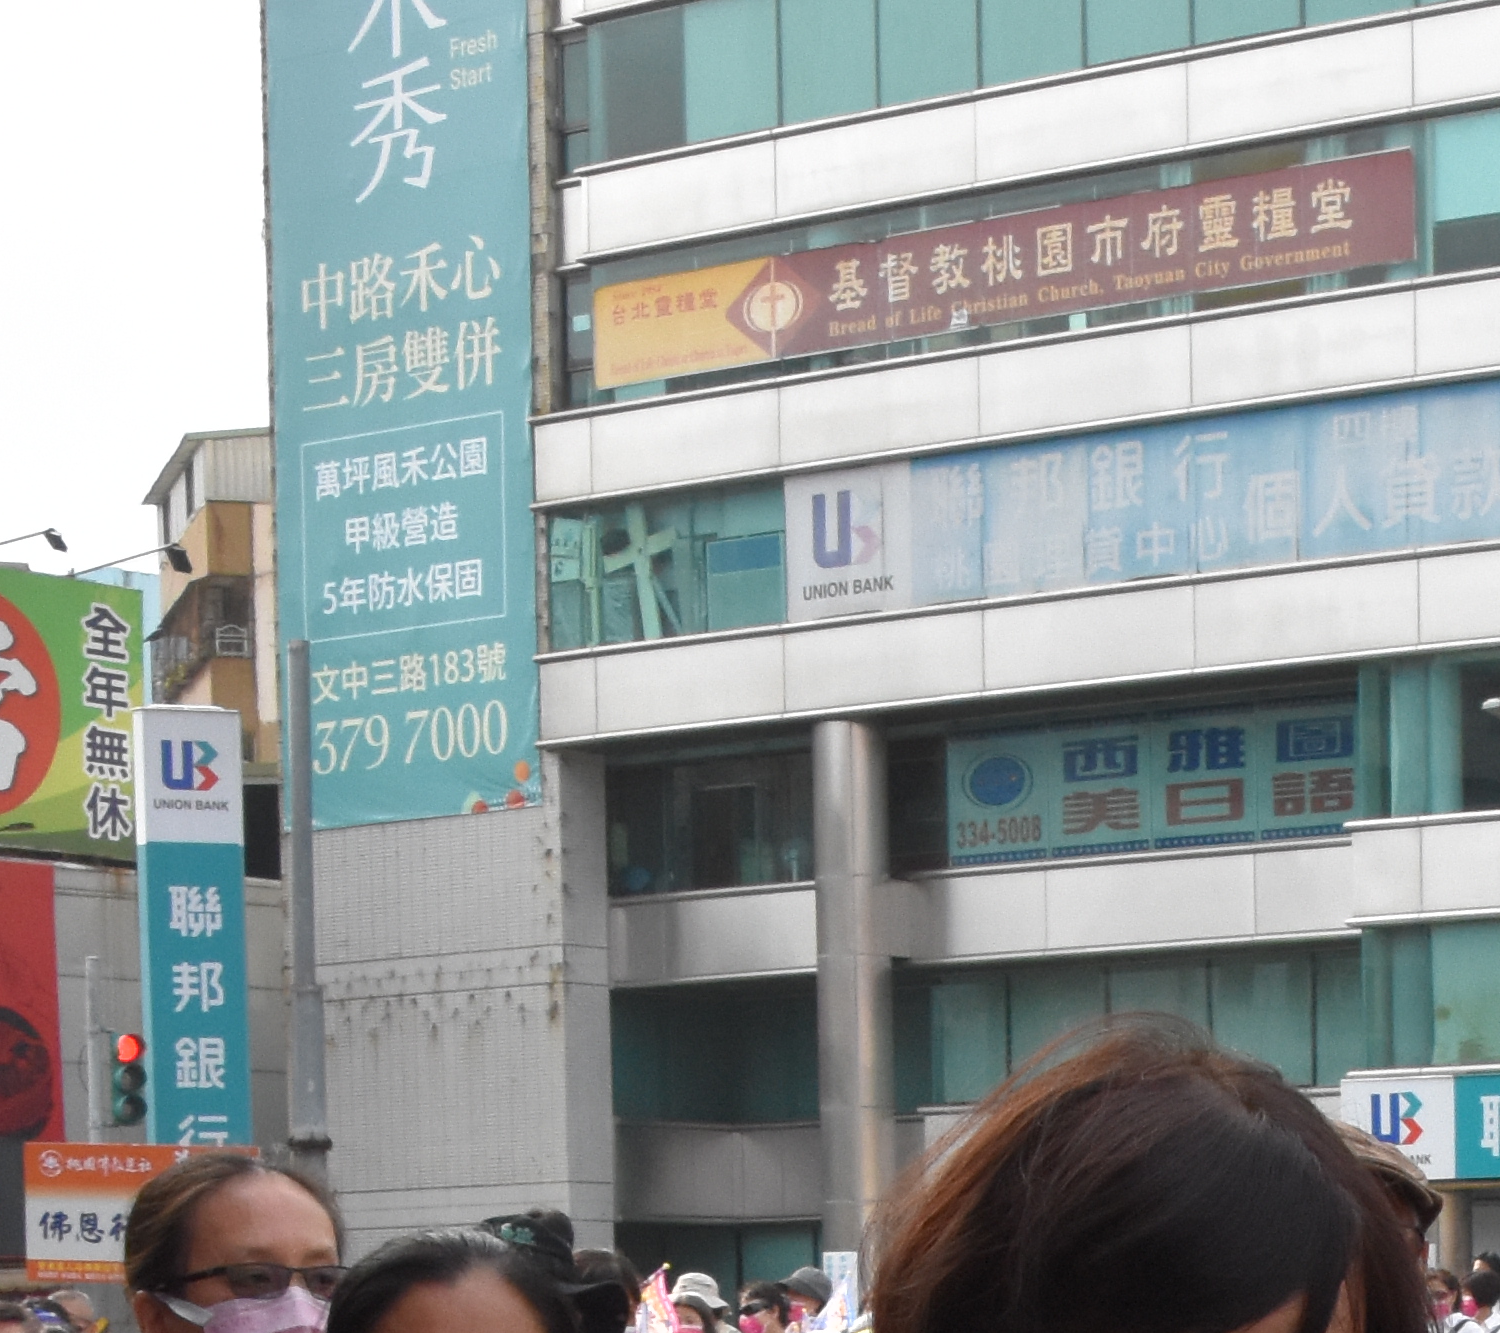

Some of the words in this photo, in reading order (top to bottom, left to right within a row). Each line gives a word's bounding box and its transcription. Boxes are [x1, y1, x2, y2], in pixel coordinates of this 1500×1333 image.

[449, 30, 498, 58] Fresh
[450, 63, 492, 90] Start
[829, 178, 1353, 311] 基督教桃園市府靈糧堂
[302, 235, 500, 331] 中路禾心
[828, 315, 877, 338] Bread
[885, 311, 902, 329] of
[909, 305, 942, 325] Life
[950, 292, 1029, 320] Christian
[1113, 266, 1187, 292] Taoyuan
[1195, 257, 1230, 281] City
[1239, 240, 1351, 271] Government
[303, 317, 501, 411] 三房雙併
[314, 437, 488, 501] 萬坪風禾公園
[345, 503, 459, 555] 甲級營造
[323, 559, 483, 615] 5年防水保固
[802, 580, 850, 602] UNION
[852, 574, 895, 596] BANK
[312, 643, 507, 704] 文中三路183號
[81, 602, 134, 841] 全年無休
[312, 714, 390, 776] 379
[404, 699, 509, 765] 7000
[1062, 716, 1355, 782] 西雅圖
[153, 798, 193, 812] UNION
[196, 799, 229, 812] BANK
[956, 814, 1043, 850] 334-5008
[1062, 767, 1357, 835] 美日語
